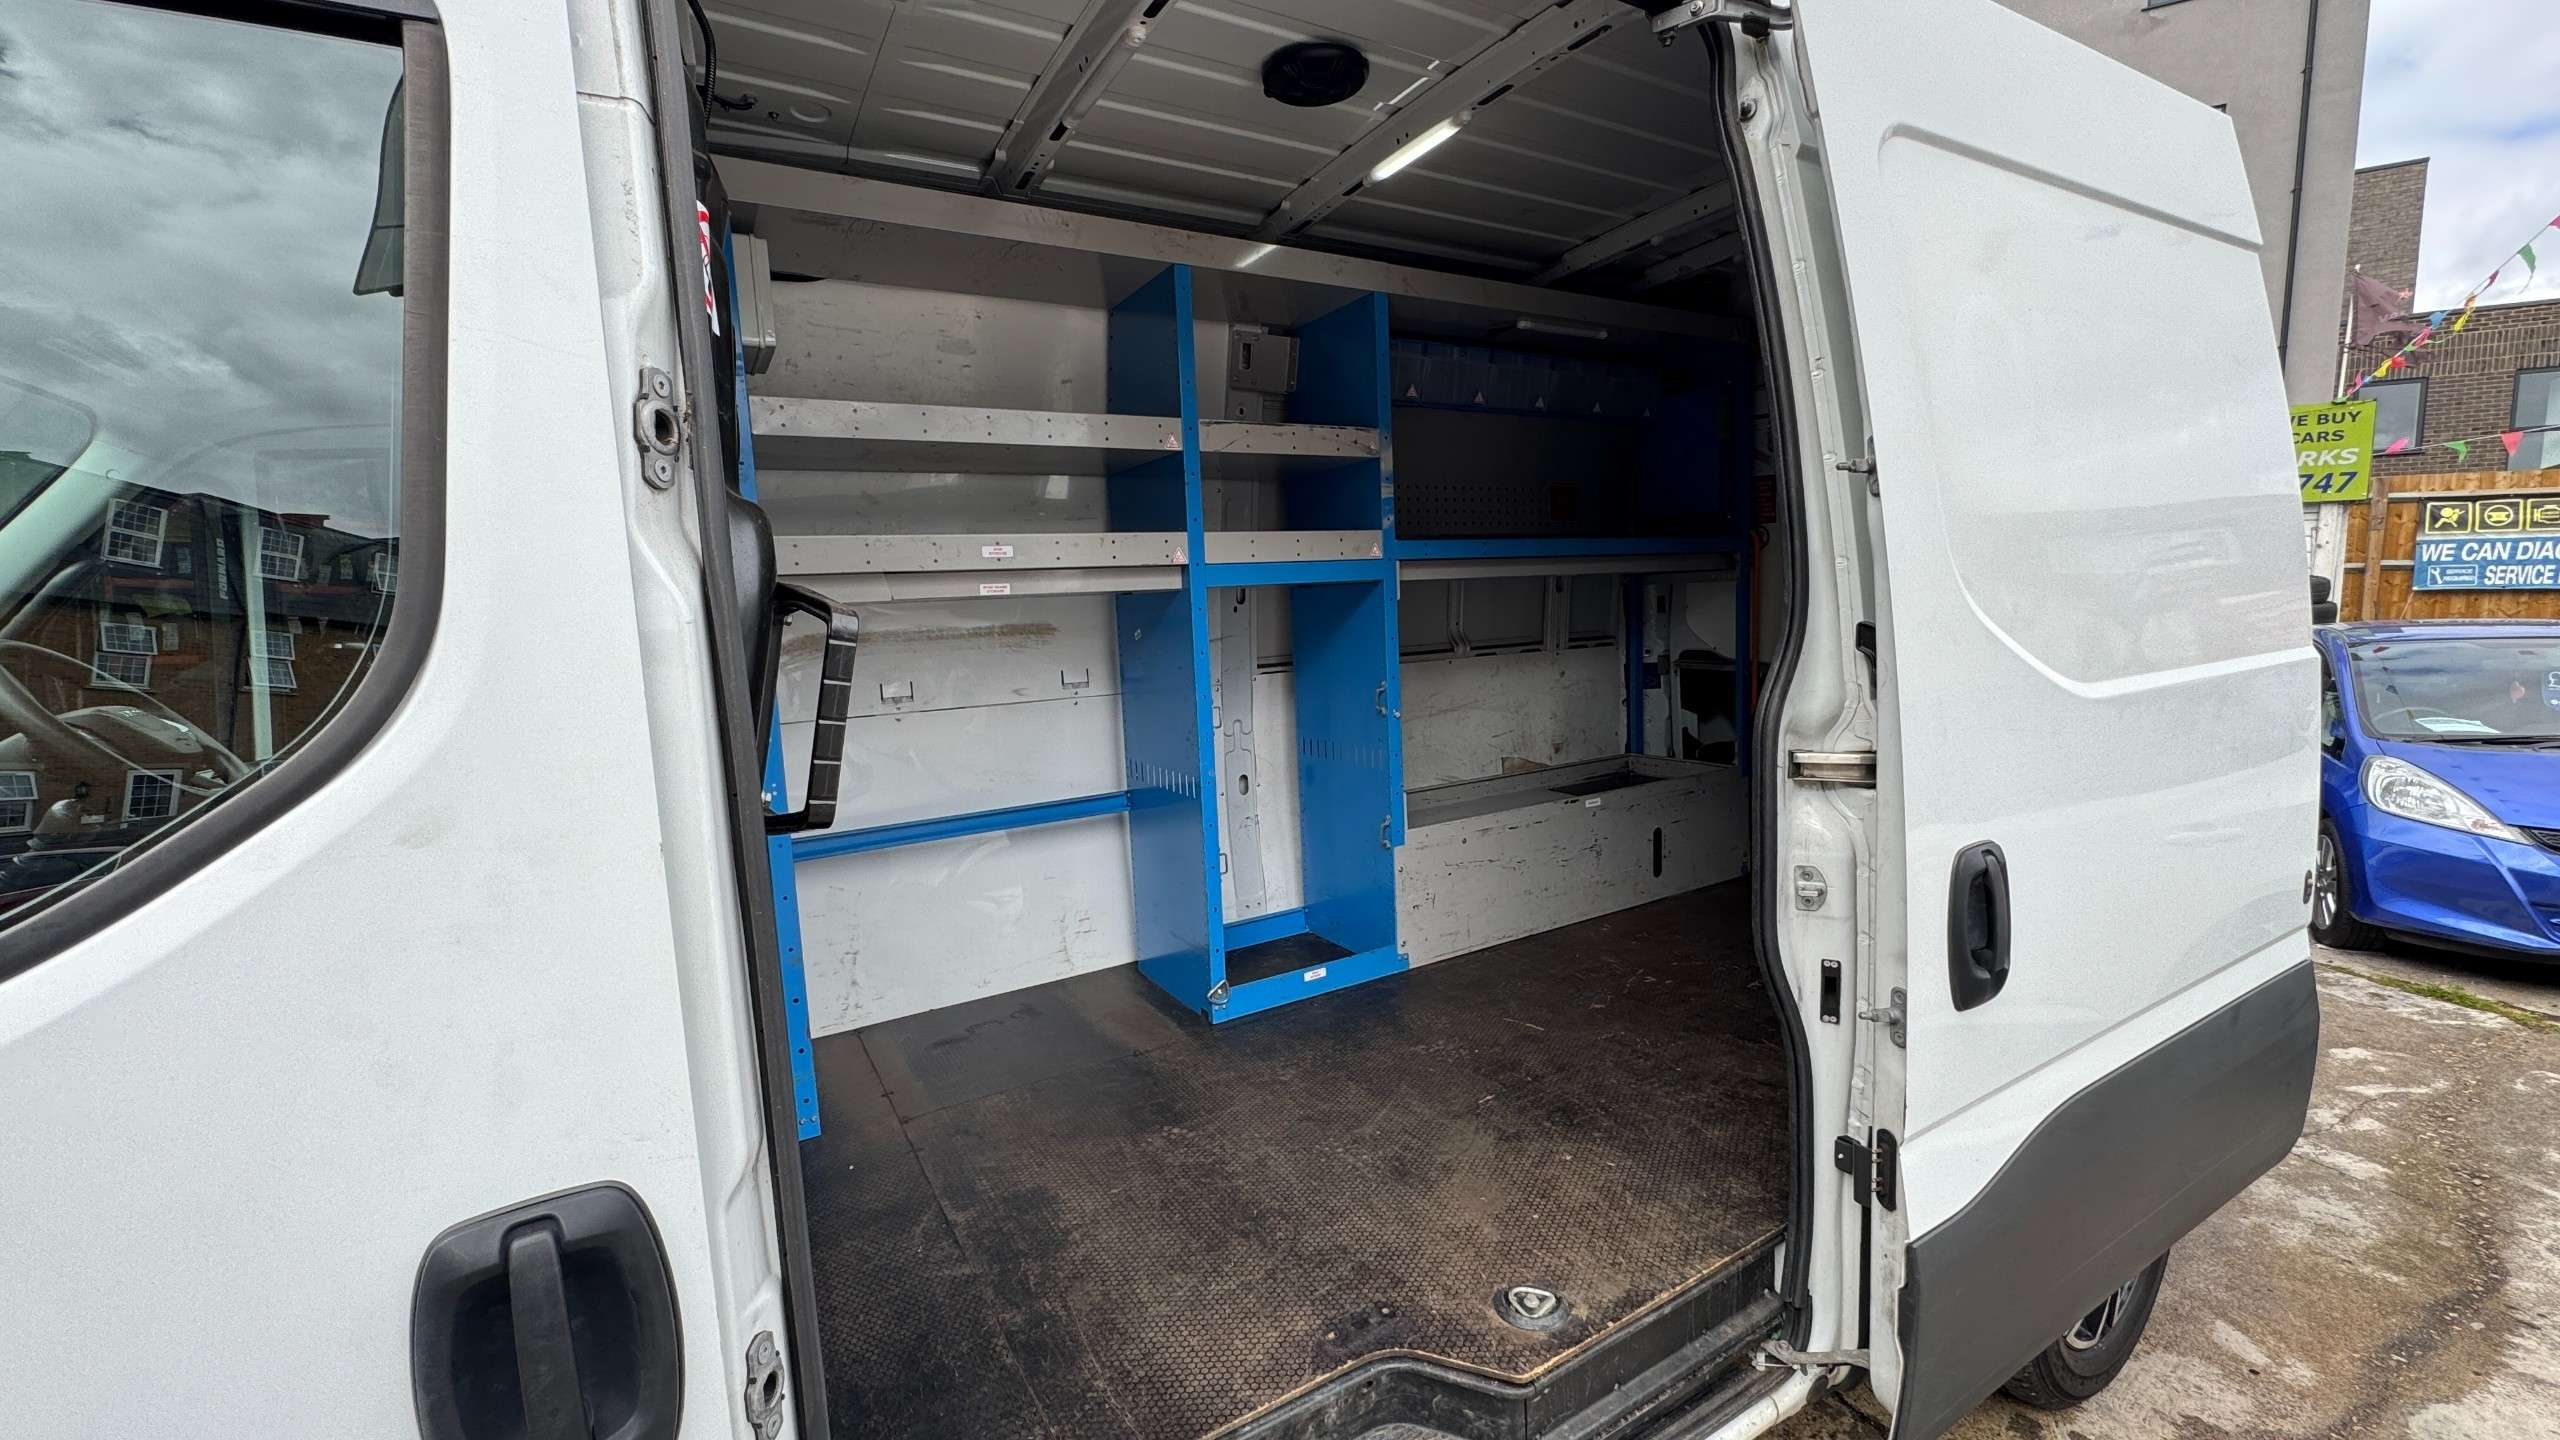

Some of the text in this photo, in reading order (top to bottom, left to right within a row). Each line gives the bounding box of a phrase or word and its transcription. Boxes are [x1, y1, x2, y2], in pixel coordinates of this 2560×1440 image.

[2291, 411, 2362, 427] E BUY
[2292, 430, 2345, 444] CARS
[2298, 448, 2360, 466] RKS
[2299, 471, 2358, 493] 747
[2422, 543, 2457, 562] WE
[2461, 541, 2512, 561] CAN
[2484, 564, 2556, 585] SERVICE
